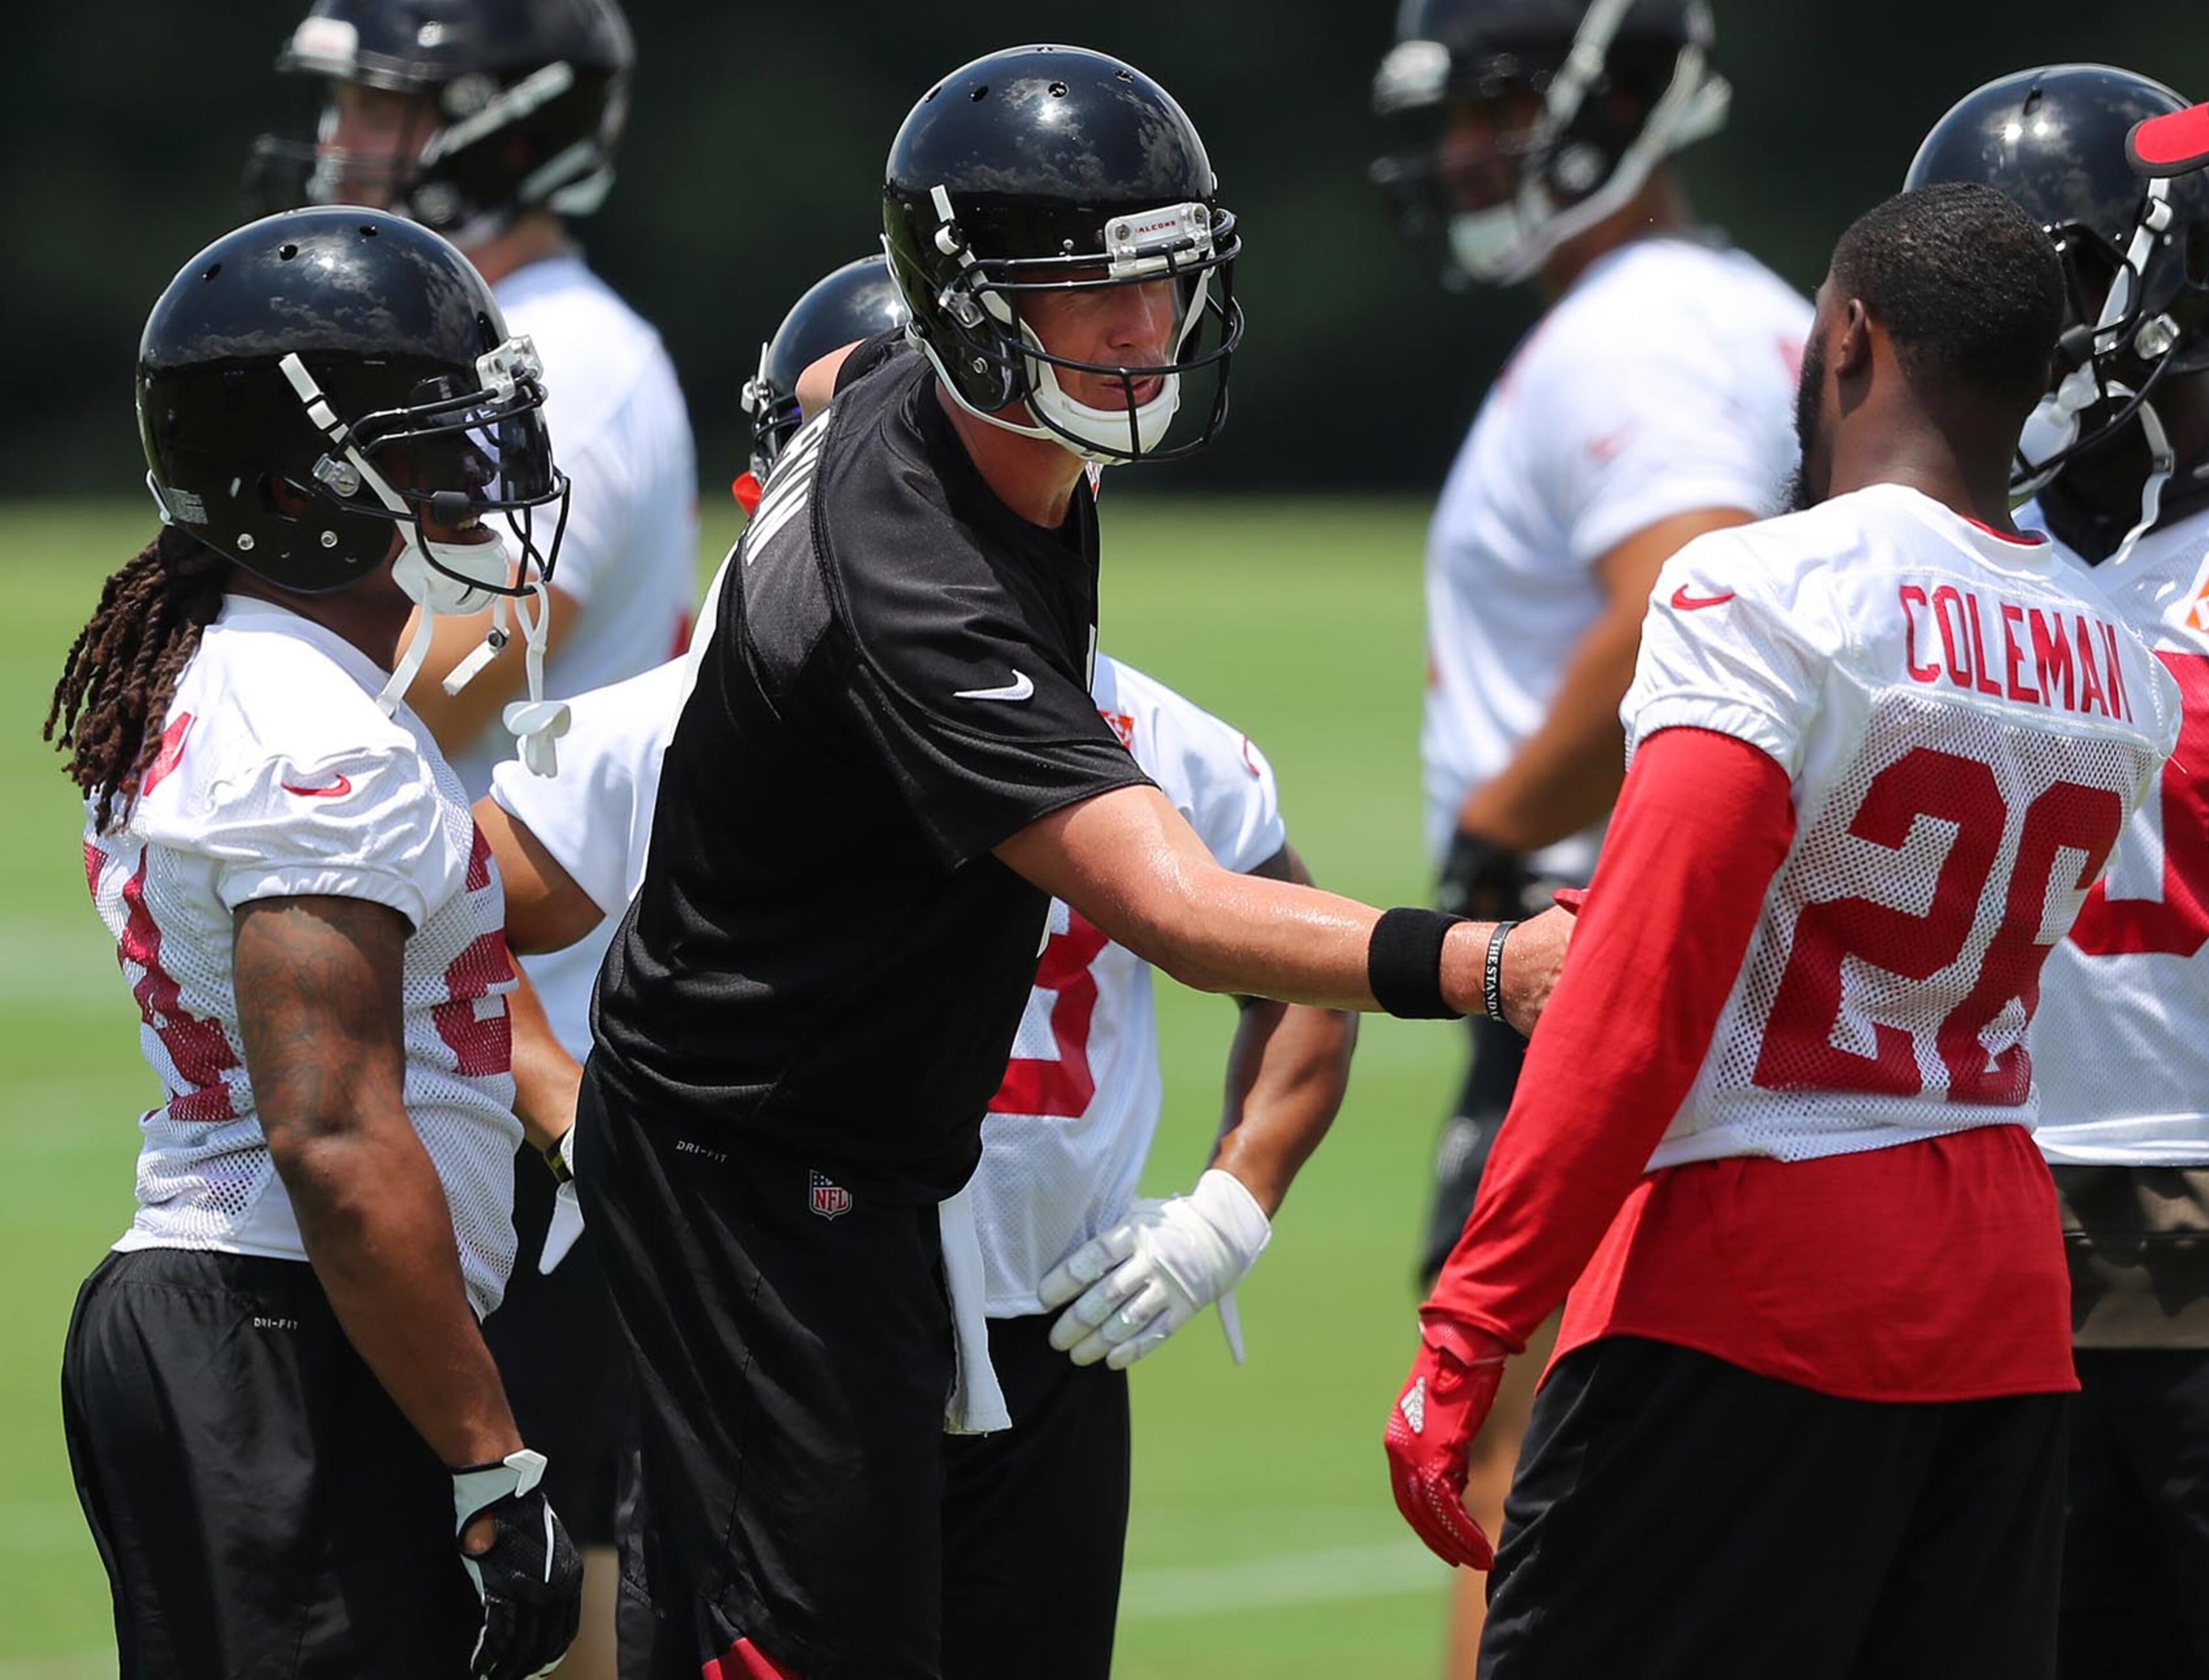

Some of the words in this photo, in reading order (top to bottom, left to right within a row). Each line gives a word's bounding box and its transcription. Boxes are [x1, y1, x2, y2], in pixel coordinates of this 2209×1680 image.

[1899, 585, 2133, 724] COLEMAN
[1752, 747, 2123, 1105] 26
[1487, 938, 1502, 965] THE
[675, 1140, 728, 1162] DRI-FIT
[815, 1189, 847, 1212] NFL
[254, 1317, 298, 1330] DRI-FIT
